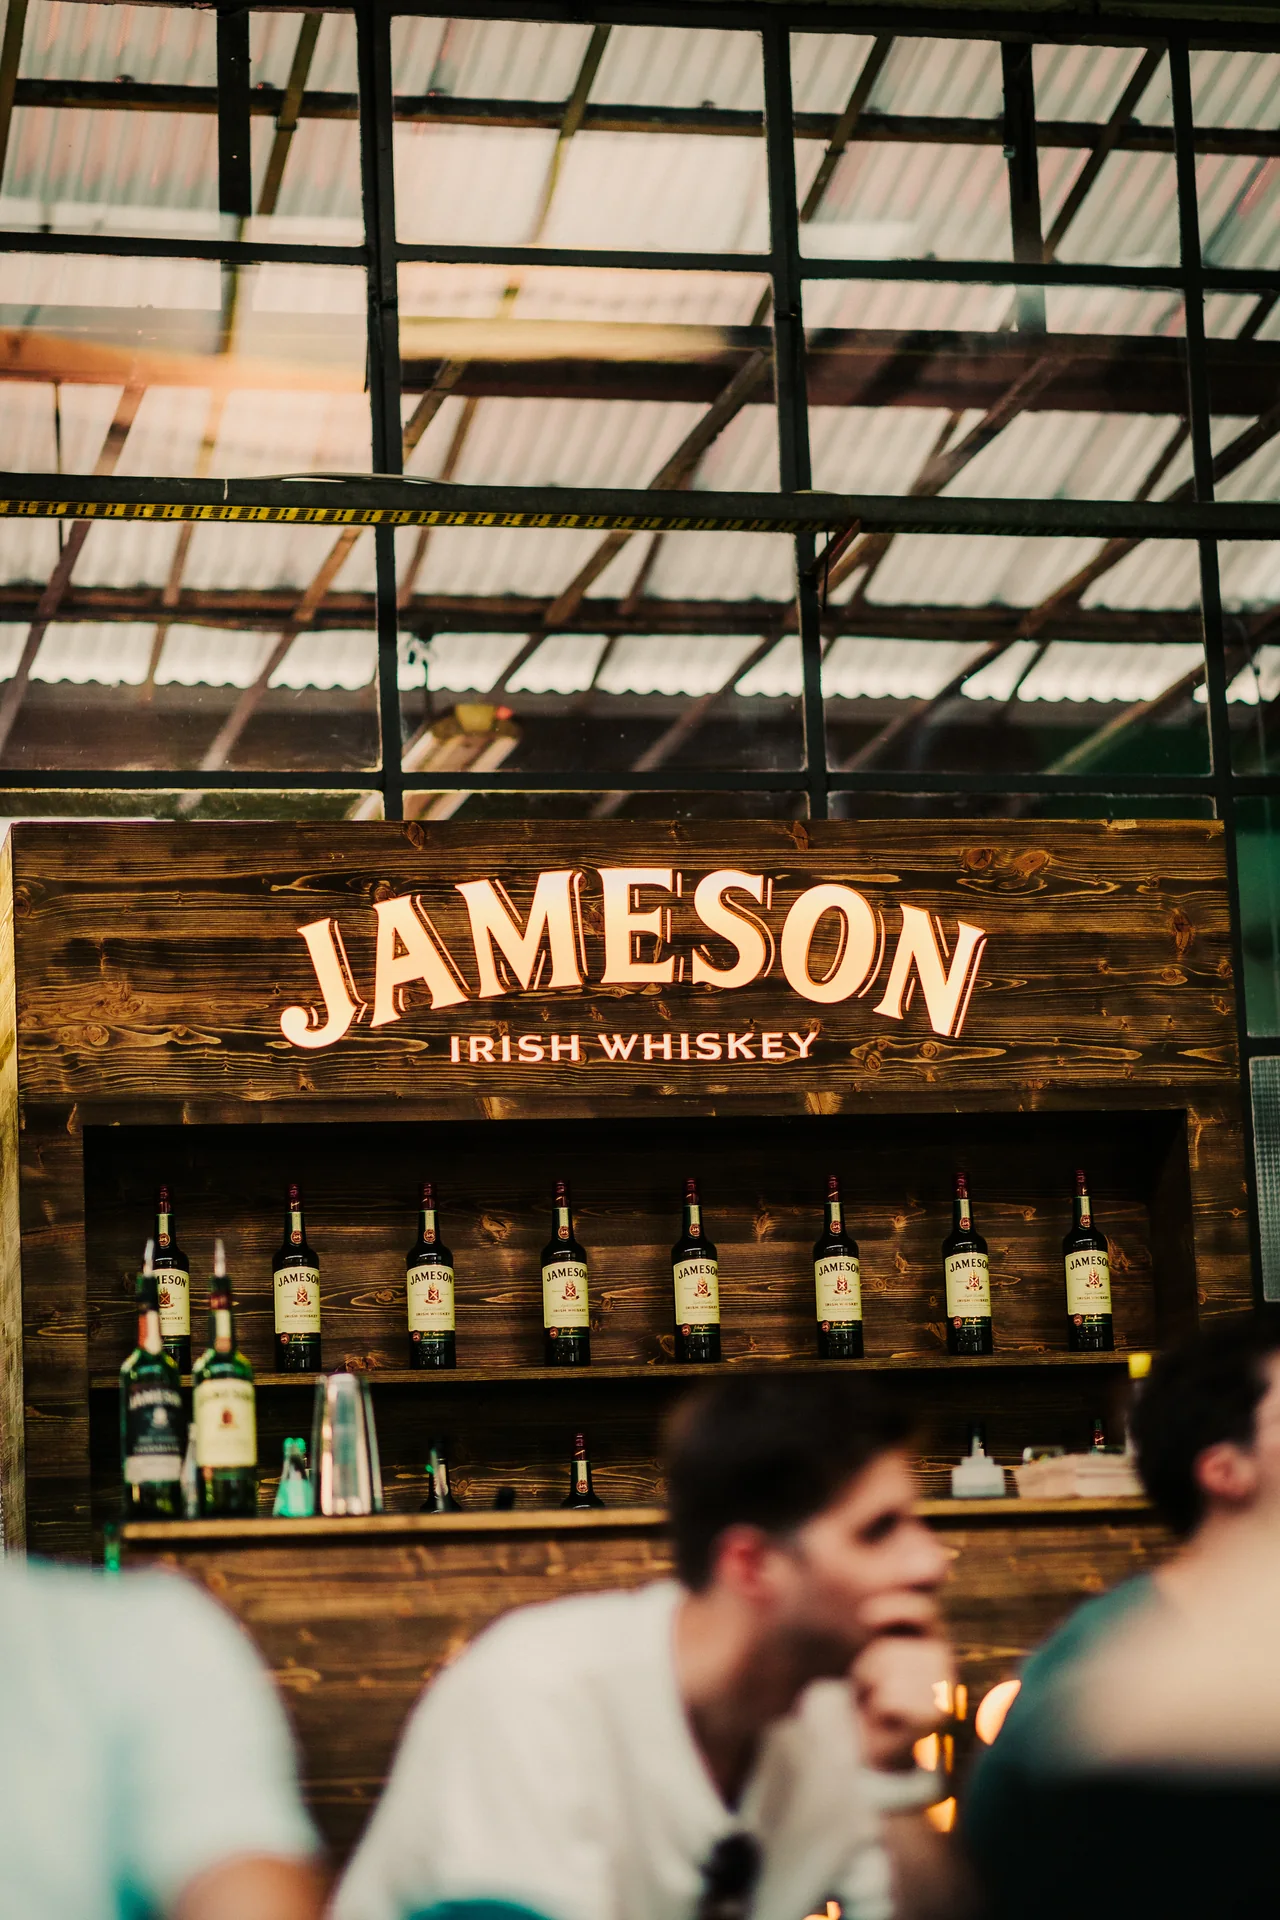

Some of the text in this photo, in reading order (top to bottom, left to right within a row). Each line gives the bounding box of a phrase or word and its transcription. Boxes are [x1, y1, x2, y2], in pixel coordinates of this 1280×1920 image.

[280, 867, 986, 1049] JAMESON
[450, 1032, 818, 1063] IRISH WHISKEY
[950, 1258, 988, 1273] JAMESO
[1069, 1255, 1108, 1270] JAMESO
[278, 1272, 319, 1287] JAMESON
[410, 1270, 453, 1286] JAMESON
[546, 1267, 588, 1282] JAMESON
